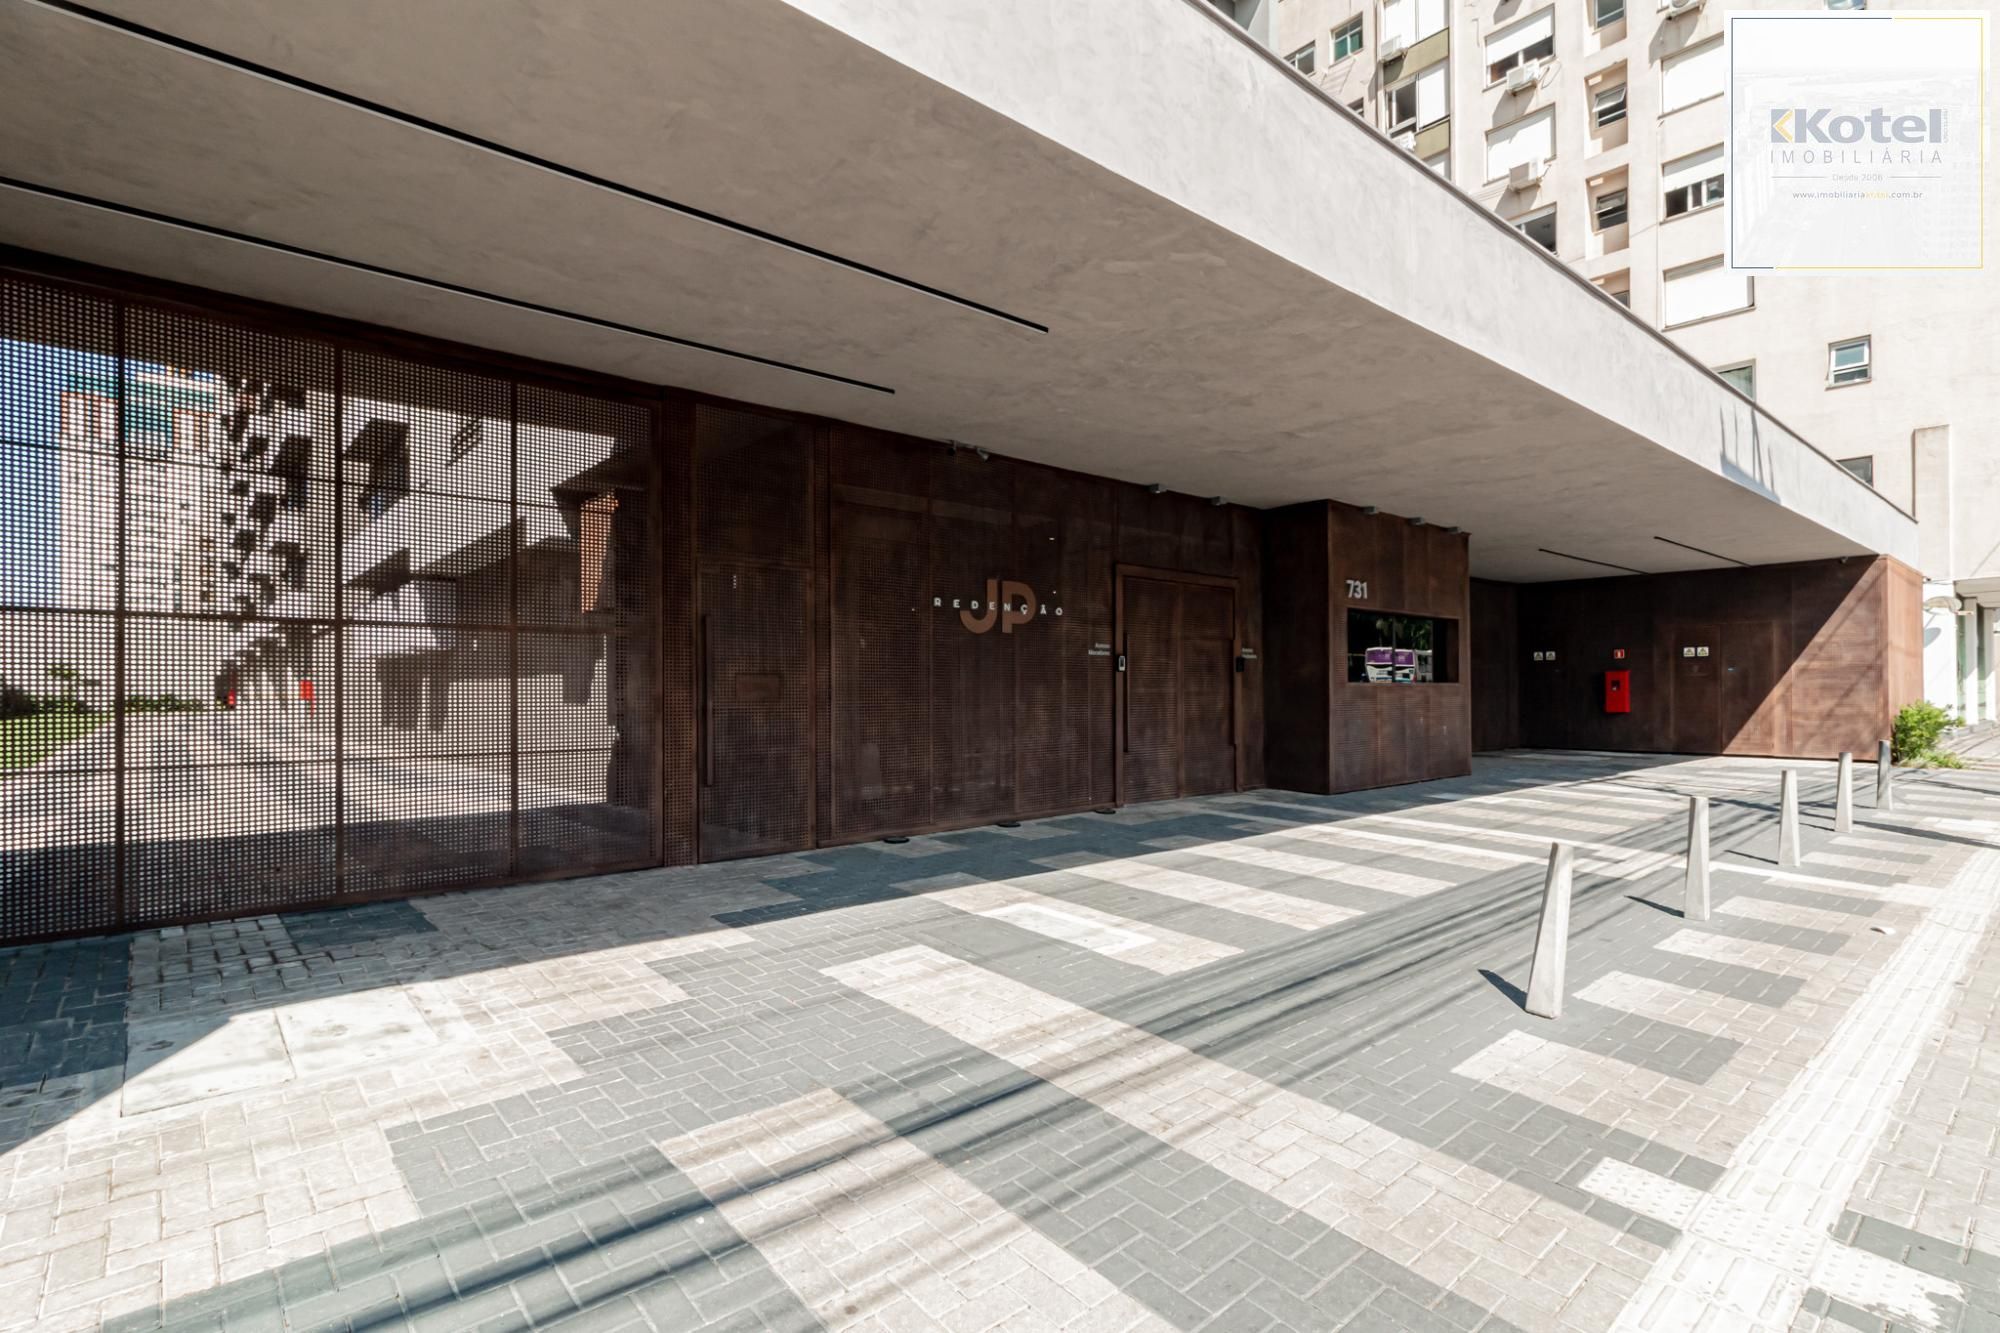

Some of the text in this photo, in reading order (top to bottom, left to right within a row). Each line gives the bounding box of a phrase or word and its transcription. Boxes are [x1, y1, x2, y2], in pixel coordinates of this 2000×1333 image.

[1346, 579, 1368, 599] 731
[933, 597, 1063, 616] REDENÇÃO
[960, 578, 1037, 634] JP
